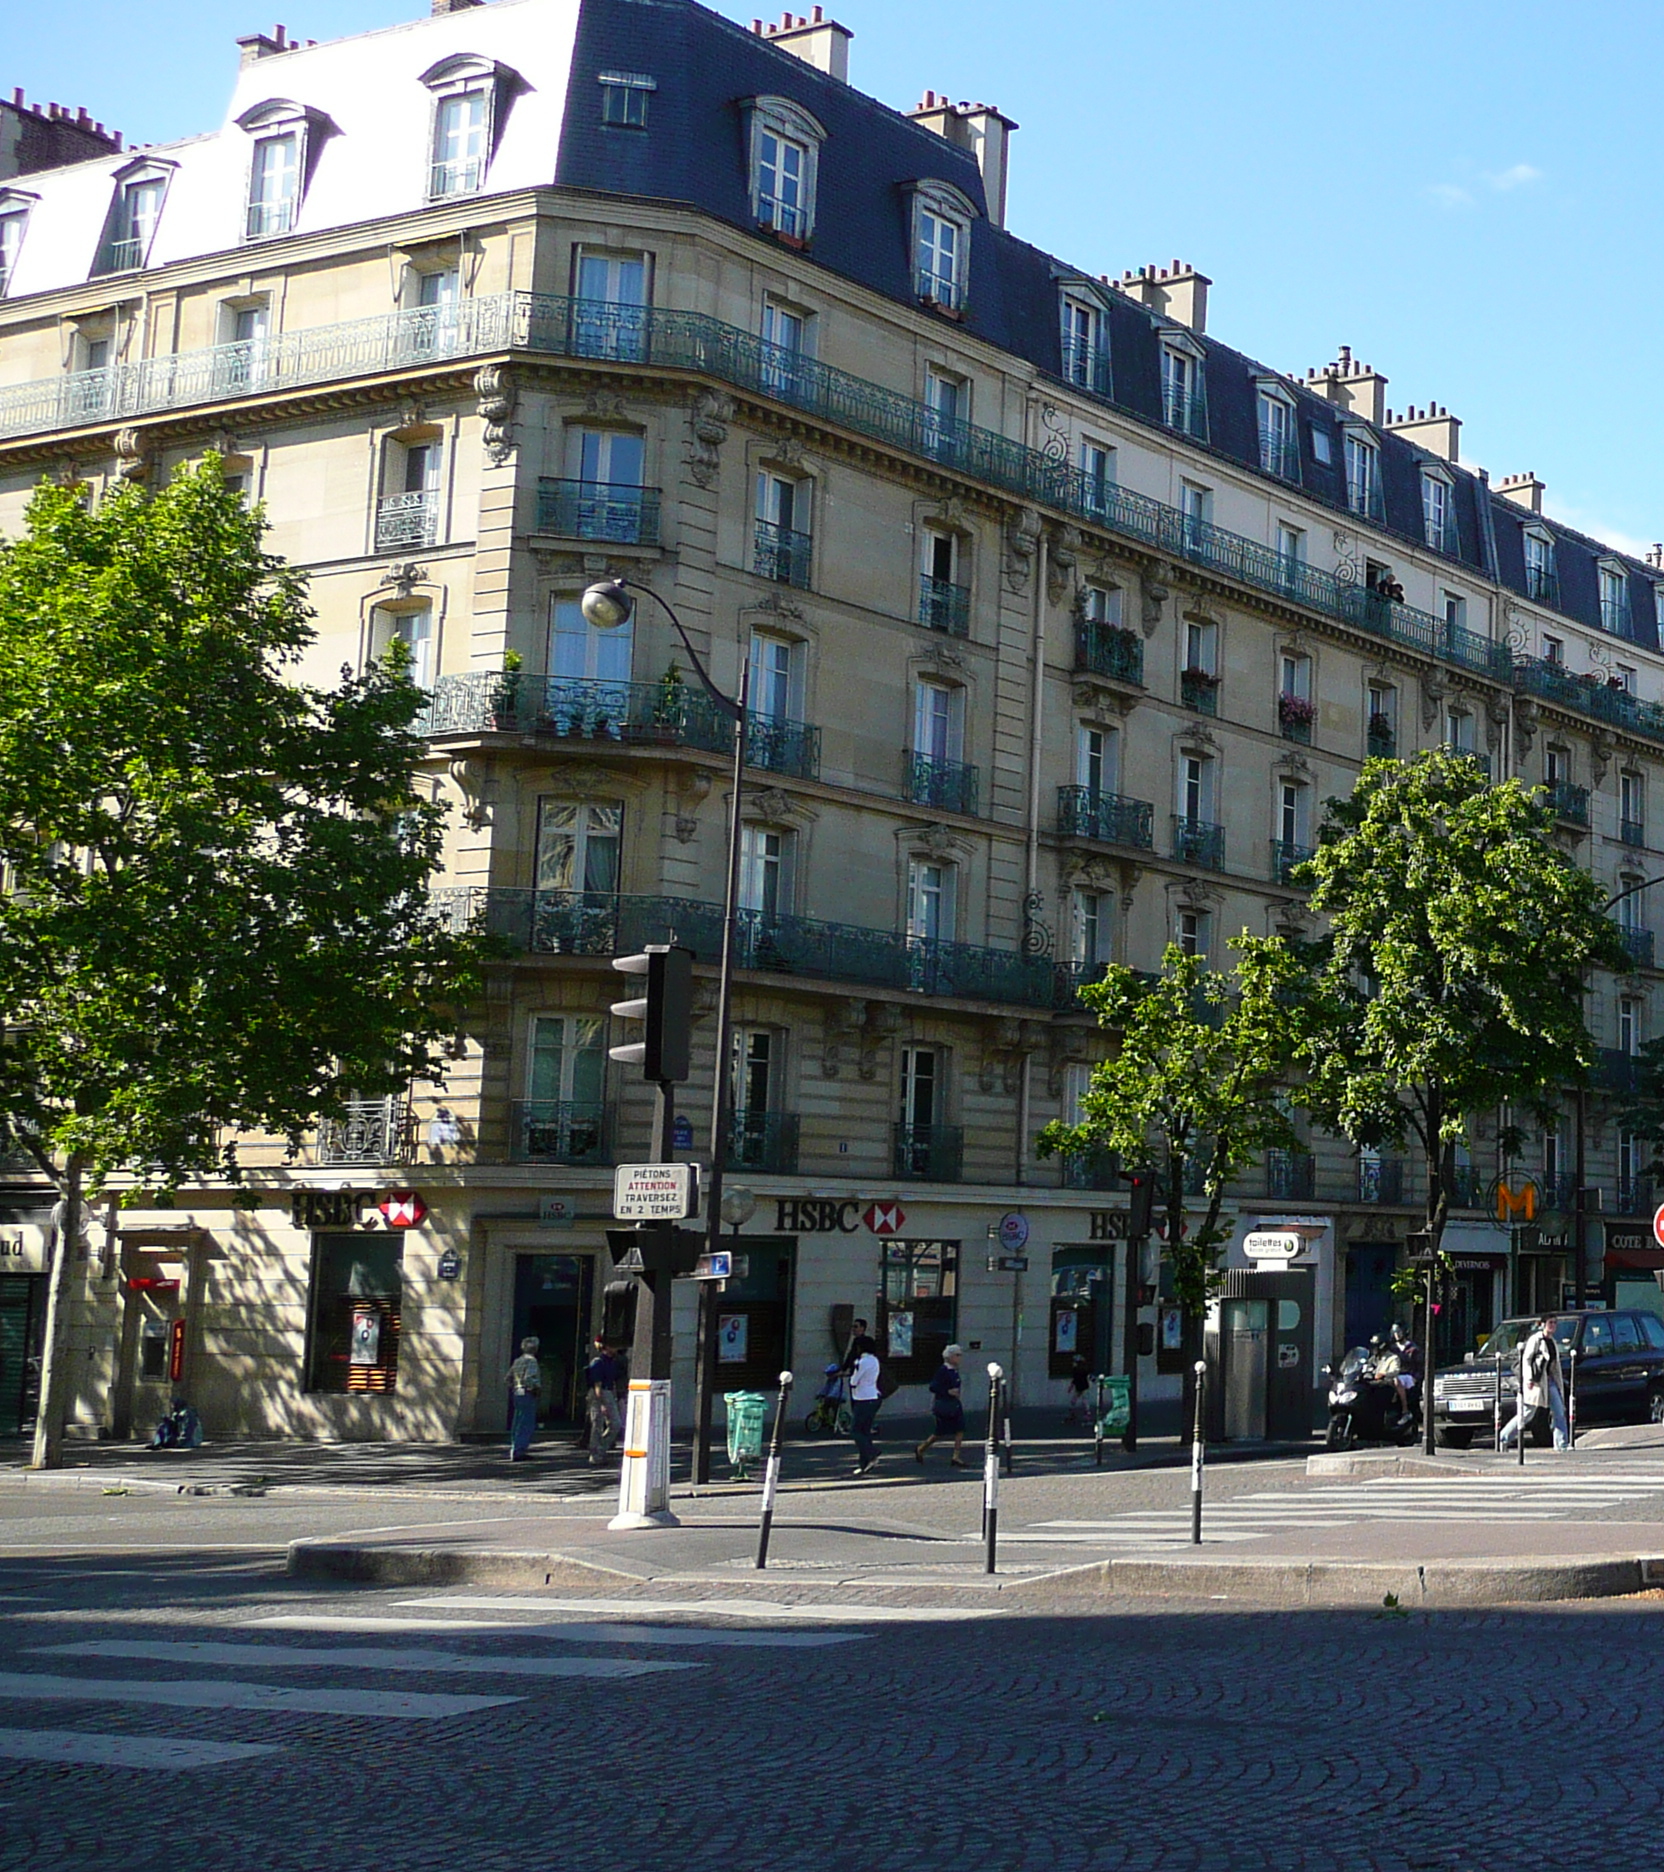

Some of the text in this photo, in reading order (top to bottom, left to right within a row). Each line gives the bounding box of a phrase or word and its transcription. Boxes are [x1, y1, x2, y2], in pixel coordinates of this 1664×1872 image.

[633, 1169, 671, 1179] PIÉTONS
[628, 1181, 677, 1191] ATTENTION
[625, 1193, 677, 1203] TRAVERSEZ
[1497, 1182, 1534, 1220] M
[290, 1192, 379, 1230] HSBC
[620, 1205, 681, 1214] EN 2 TEMPS
[775, 1200, 860, 1234] HSBC
[1249, 1237, 1282, 1247] toilettes
[716, 1257, 723, 1271] P
